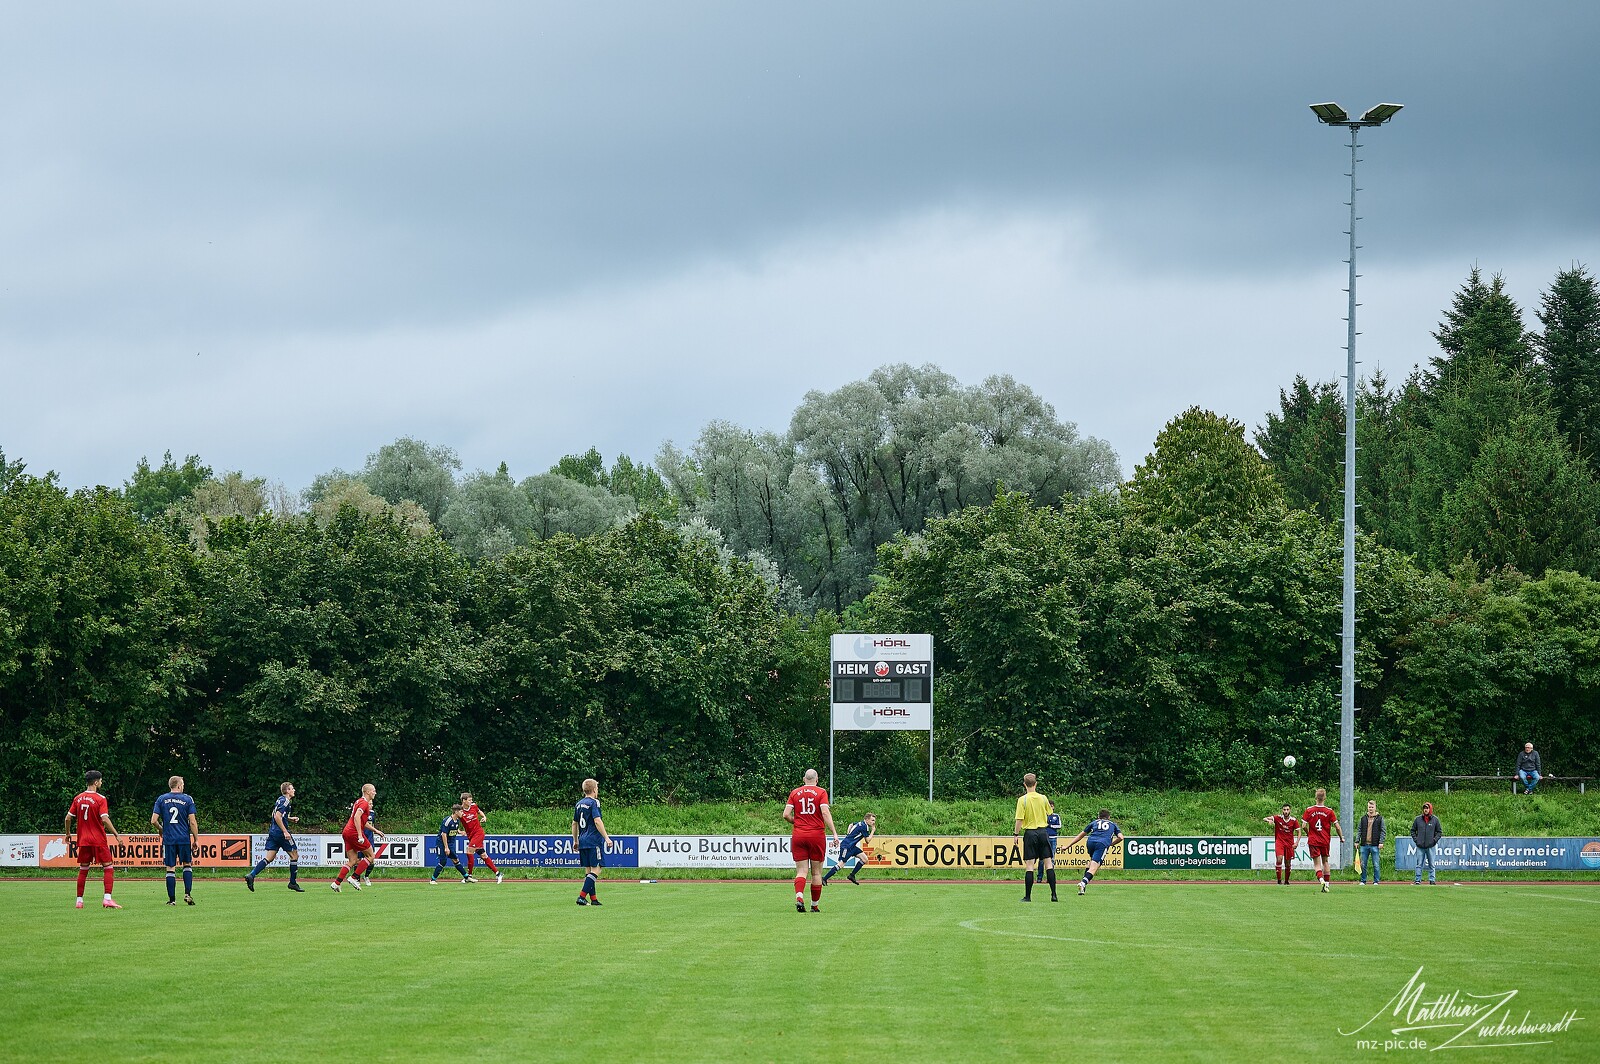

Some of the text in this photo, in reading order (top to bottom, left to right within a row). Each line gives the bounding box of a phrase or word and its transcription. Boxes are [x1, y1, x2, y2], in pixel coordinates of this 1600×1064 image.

[874, 637, 911, 647] HÖRL
[838, 664, 869, 674] HEIM
[896, 664, 927, 674] GAST
[873, 707, 911, 716] HÖRL
[799, 797, 816, 815] 15
[81, 804, 90, 820] 7
[169, 806, 179, 824] 2
[580, 812, 587, 829] 6
[1096, 820, 1110, 831] 16
[1315, 818, 1323, 831] 4
[647, 838, 692, 853] Auto
[1075, 845, 1085, 854] 86
[1111, 845, 1122, 854] 22
[1127, 840, 1194, 855] Gasthaus
[1197, 840, 1252, 855] Greimel
[1406, 844, 1467, 856] Mhael
[1471, 844, 1566, 856] Niedermeier
[895, 839, 1024, 866] STÖCKL-BA
[1152, 857, 1227, 866] das urig-bayrische
[1425, 859, 1548, 868] Snitär Heizung Kundendienst
